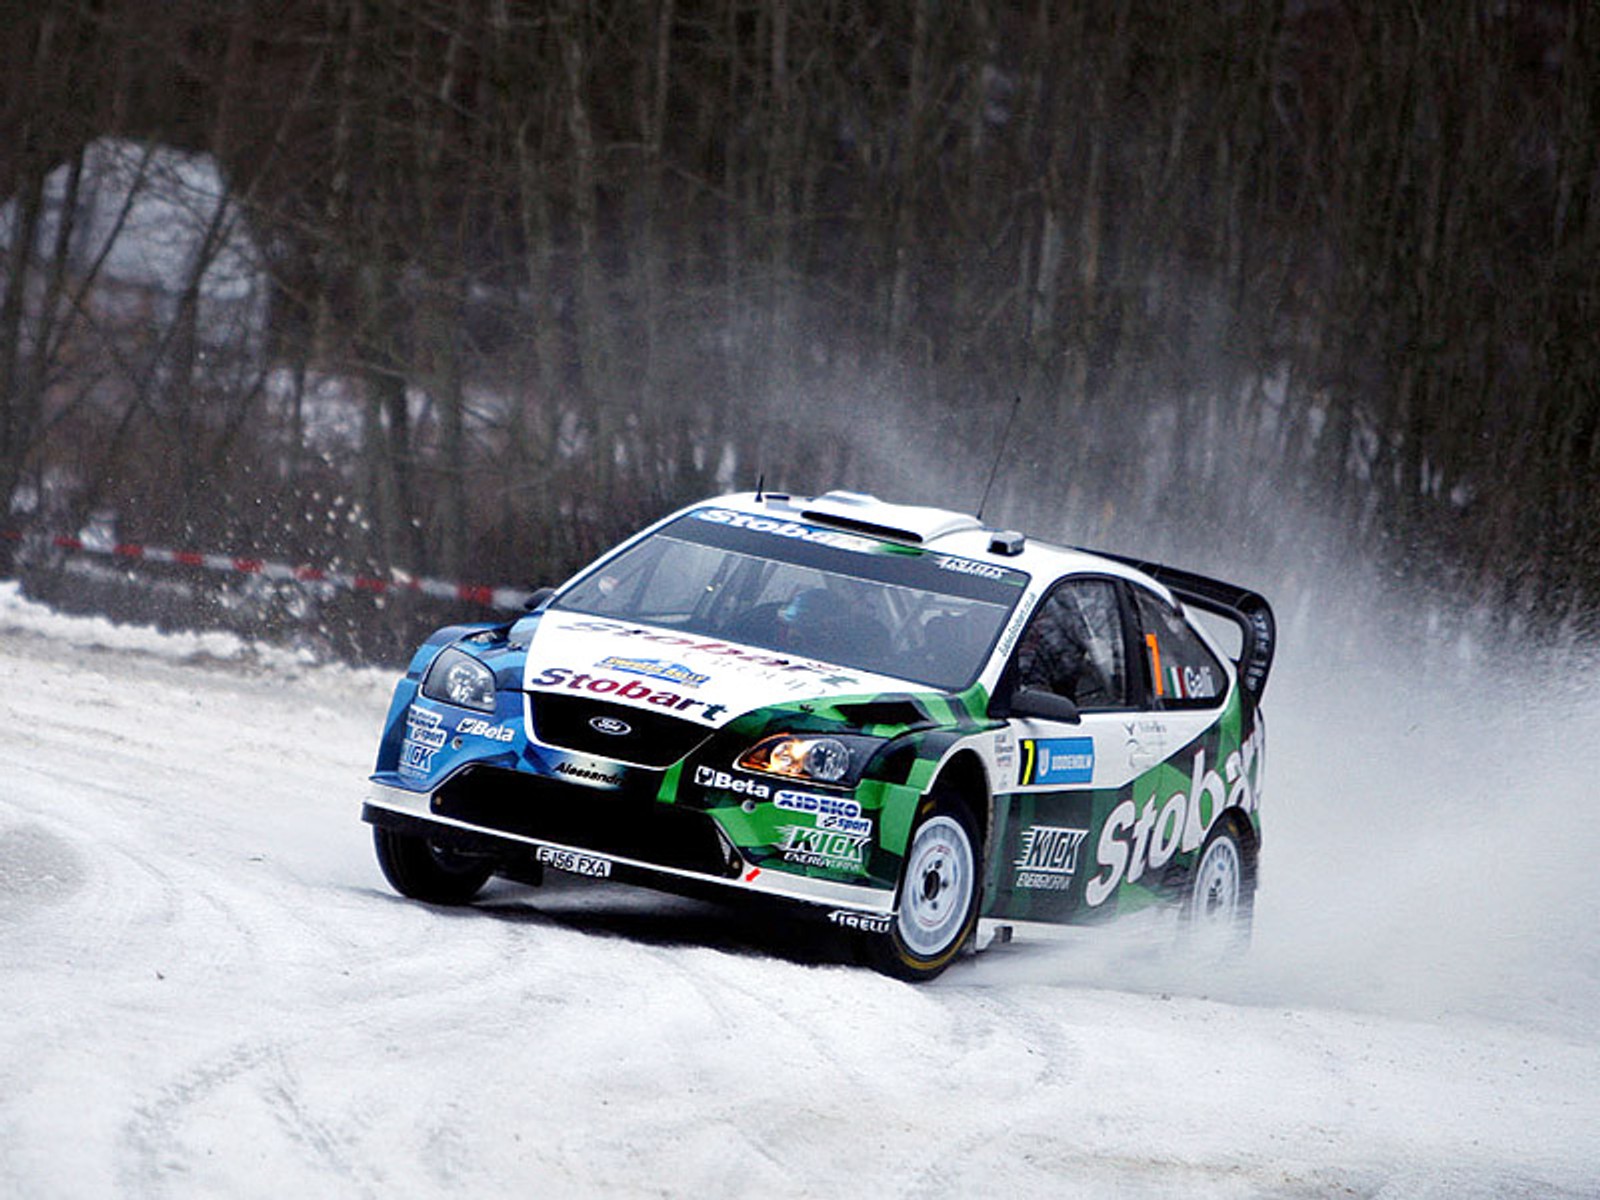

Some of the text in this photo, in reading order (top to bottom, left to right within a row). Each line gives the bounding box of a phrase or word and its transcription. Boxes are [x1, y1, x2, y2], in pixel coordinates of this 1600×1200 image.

[531, 667, 728, 722] Stobart
[1022, 739, 1036, 786] 7
[714, 770, 771, 799] Beta
[838, 818, 870, 833] sport
[787, 829, 870, 863] KICK
[578, 857, 607, 877] FXA
